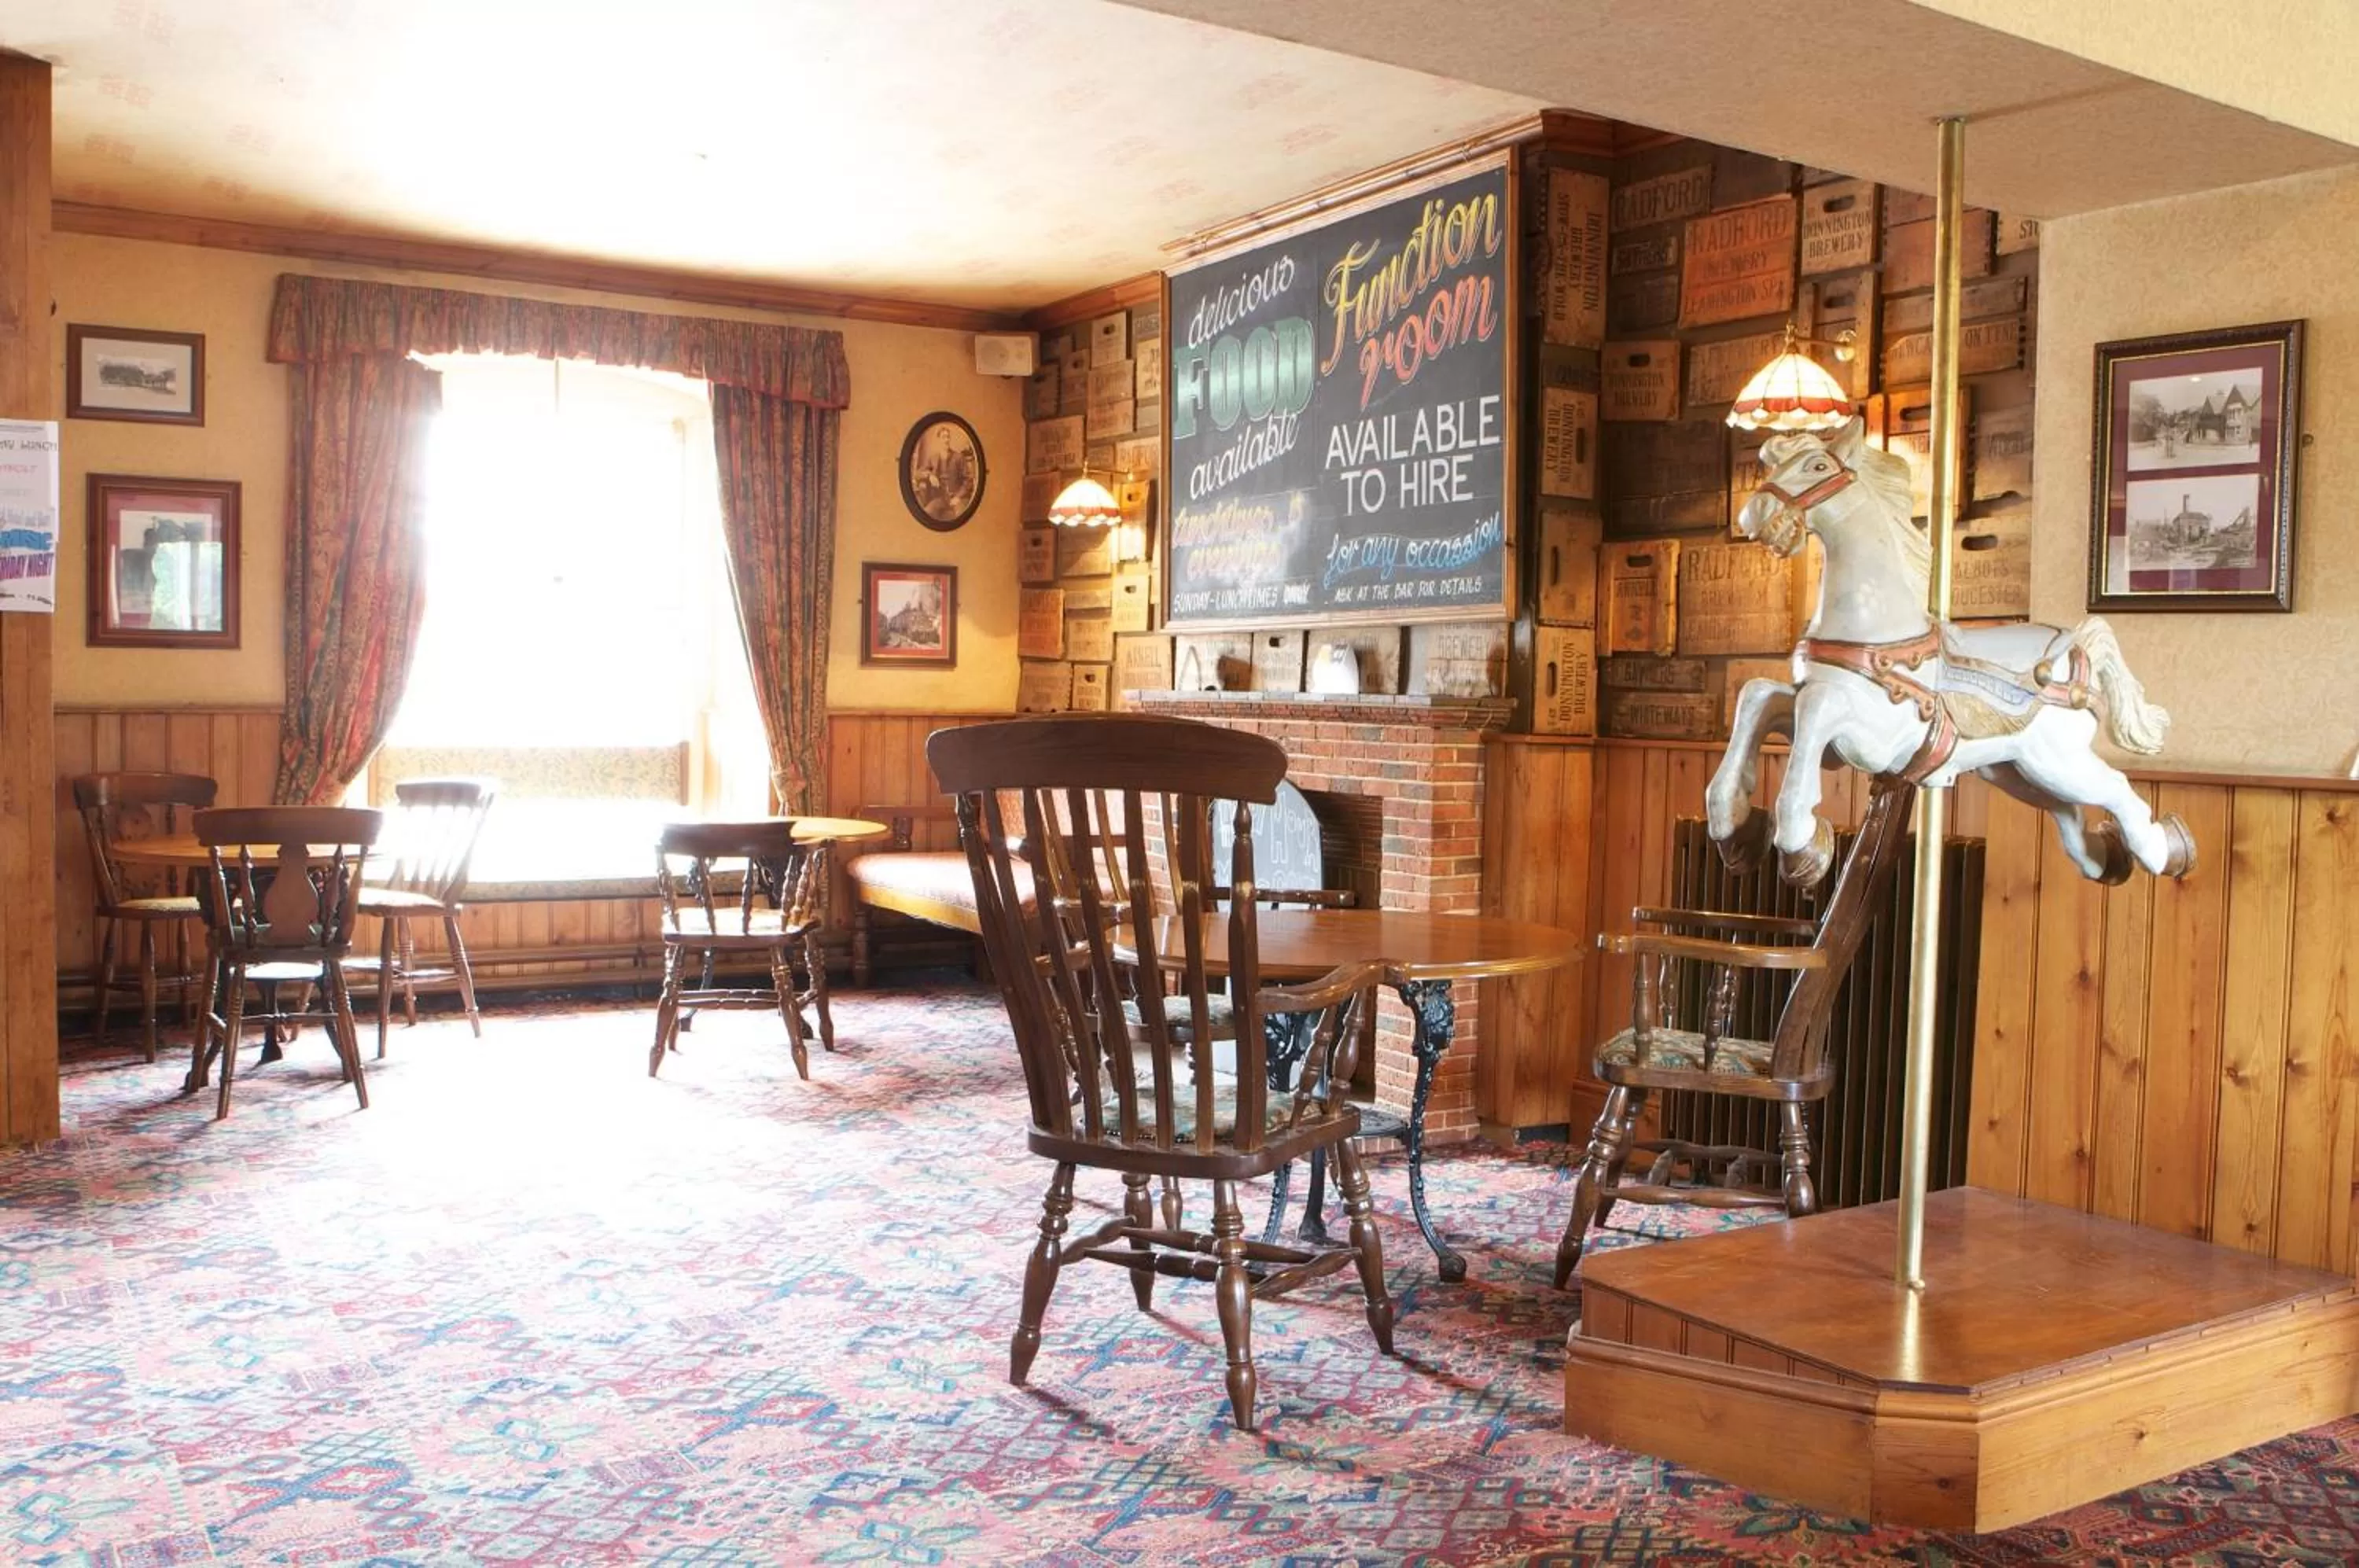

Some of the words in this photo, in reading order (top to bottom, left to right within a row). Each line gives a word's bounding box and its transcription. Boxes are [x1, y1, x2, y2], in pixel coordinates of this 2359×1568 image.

[1614, 172, 1703, 229] RADFORD
[1691, 203, 1788, 256] RADFORD
[1803, 209, 1871, 239] DONNINGTON
[1809, 230, 1865, 259] BREWERY
[1188, 254, 1296, 349] delicious
[1321, 192, 1503, 377] Function
[1358, 273, 1498, 413] room
[1173, 316, 1316, 440] FOOD
[1190, 407, 1300, 501] available
[1325, 395, 1501, 469] AVAILABLE
[1340, 468, 1387, 517] TO
[1399, 453, 1474, 510] HIRE
[1323, 532, 1359, 590] for
[1361, 534, 1400, 580] any
[1356, 583, 1369, 602] AT
[1372, 583, 1391, 600] THE
[1394, 580, 1415, 598] BAR
[1418, 578, 1437, 598] FOR
[1440, 575, 1482, 594] DETAILS
[1559, 642, 1575, 721] DONNINGTON
[1574, 649, 1588, 715] BREWERY
